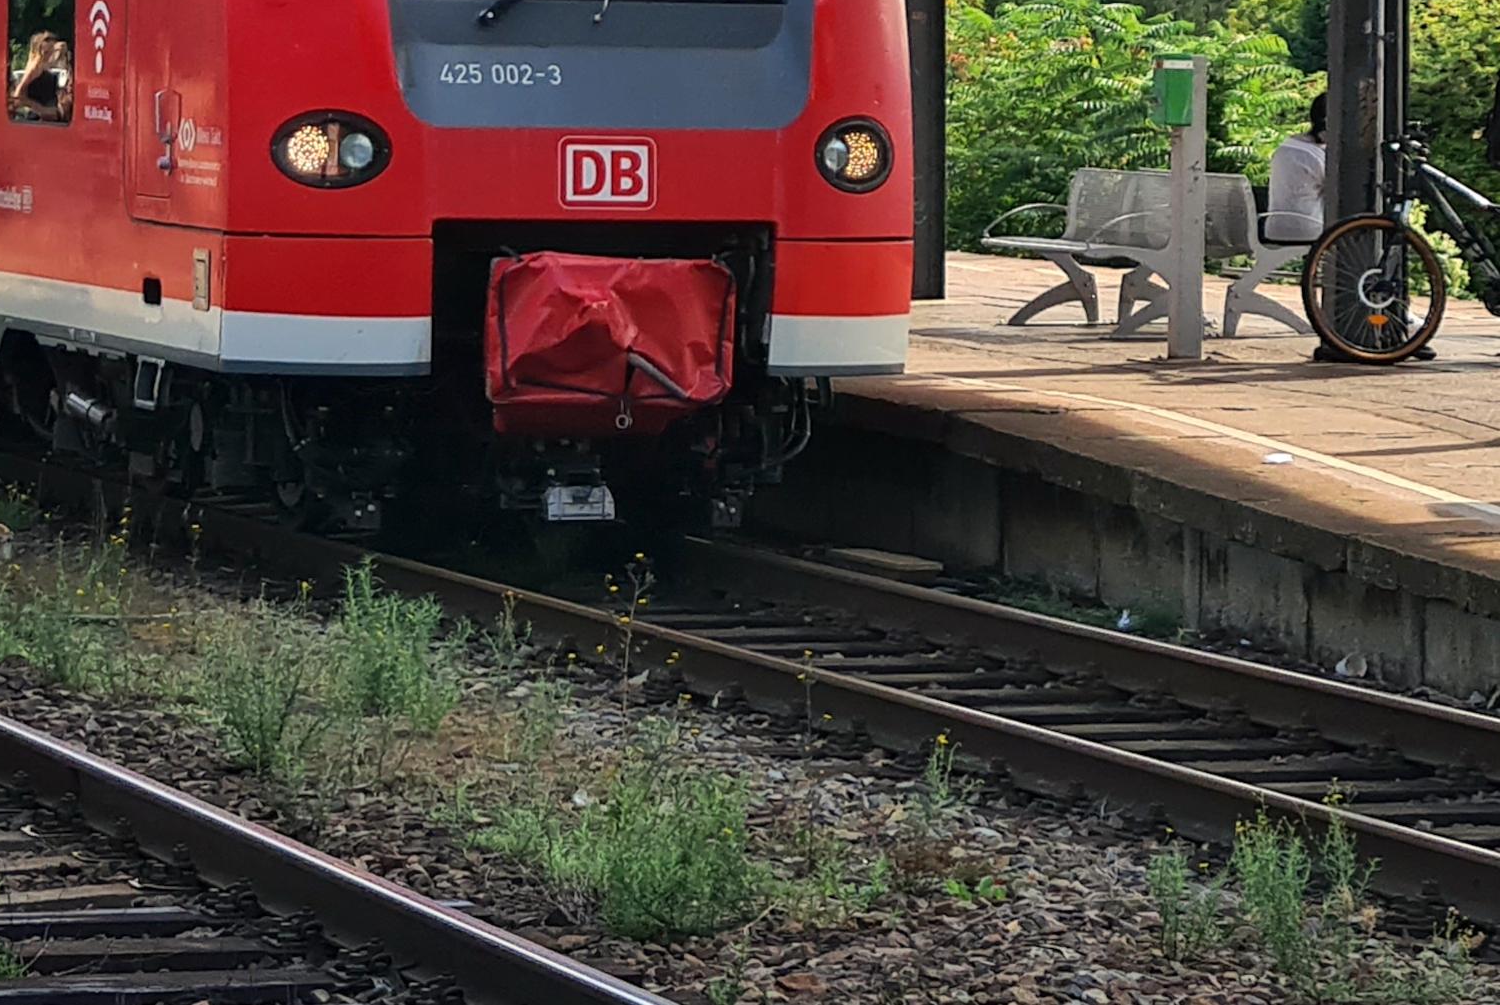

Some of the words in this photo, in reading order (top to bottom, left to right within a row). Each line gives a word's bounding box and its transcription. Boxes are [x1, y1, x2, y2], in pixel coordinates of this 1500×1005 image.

[440, 63, 482, 84] 425
[491, 63, 563, 85] 002-3
[573, 149, 644, 197] DB
